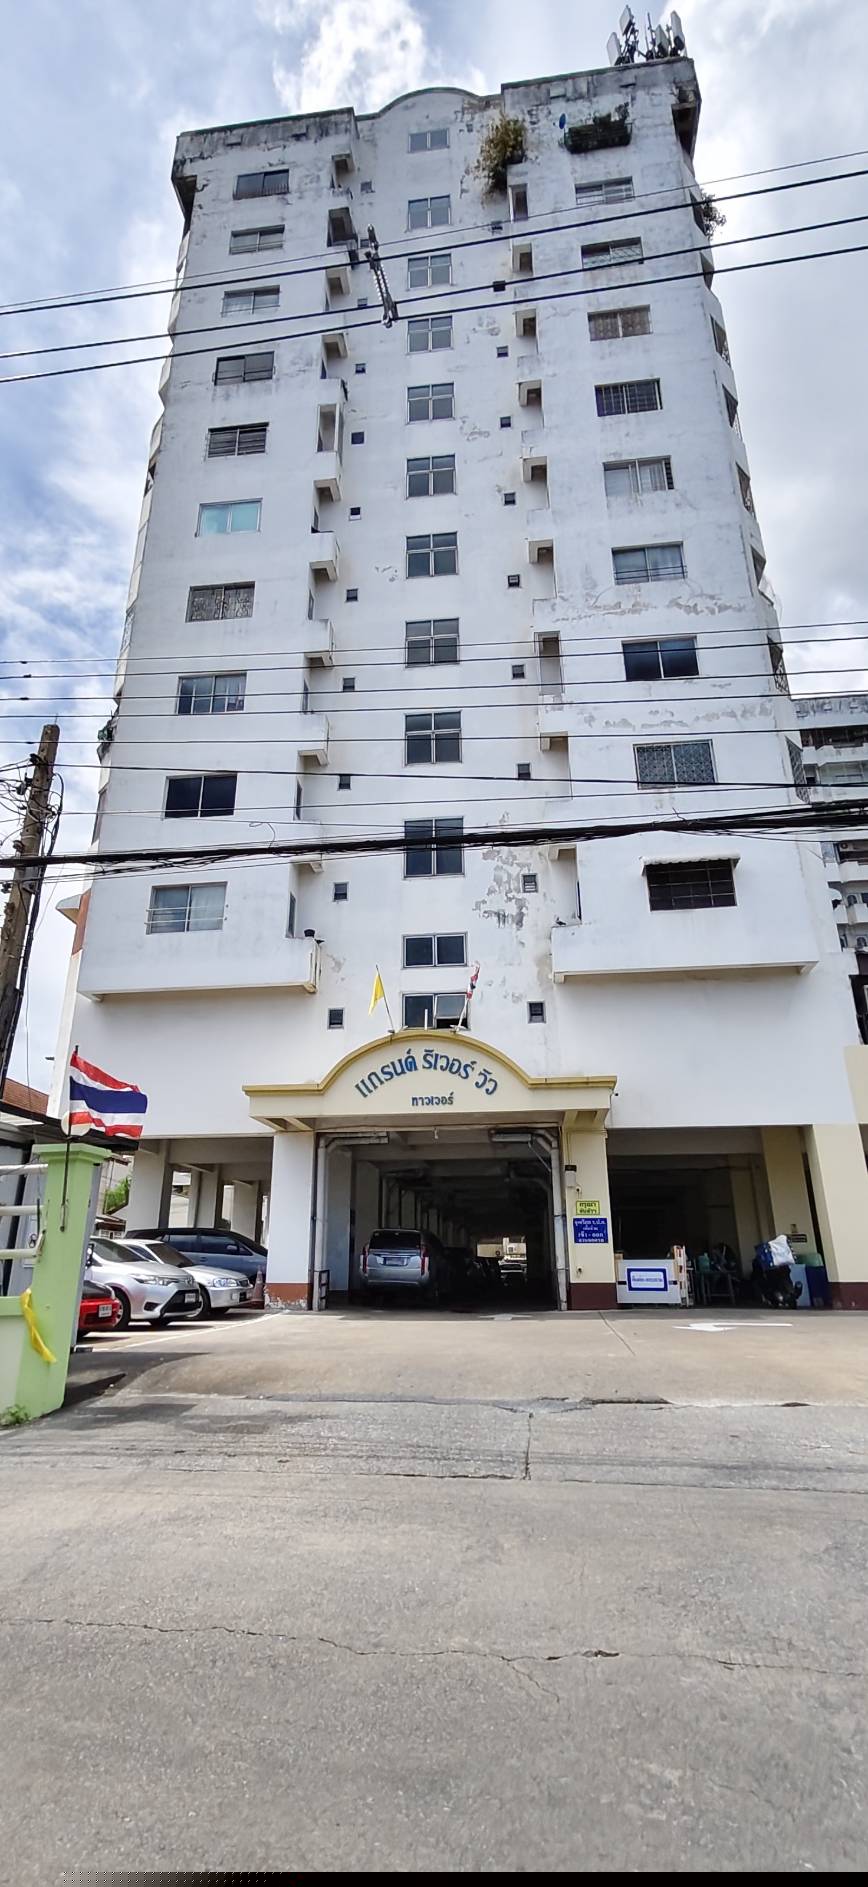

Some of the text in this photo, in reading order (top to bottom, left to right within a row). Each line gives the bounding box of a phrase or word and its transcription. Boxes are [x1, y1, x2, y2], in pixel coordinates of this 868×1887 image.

[354, 1048, 418, 1098] แกรนด์
[411, 1091, 454, 1107] ทาวเวอร์
